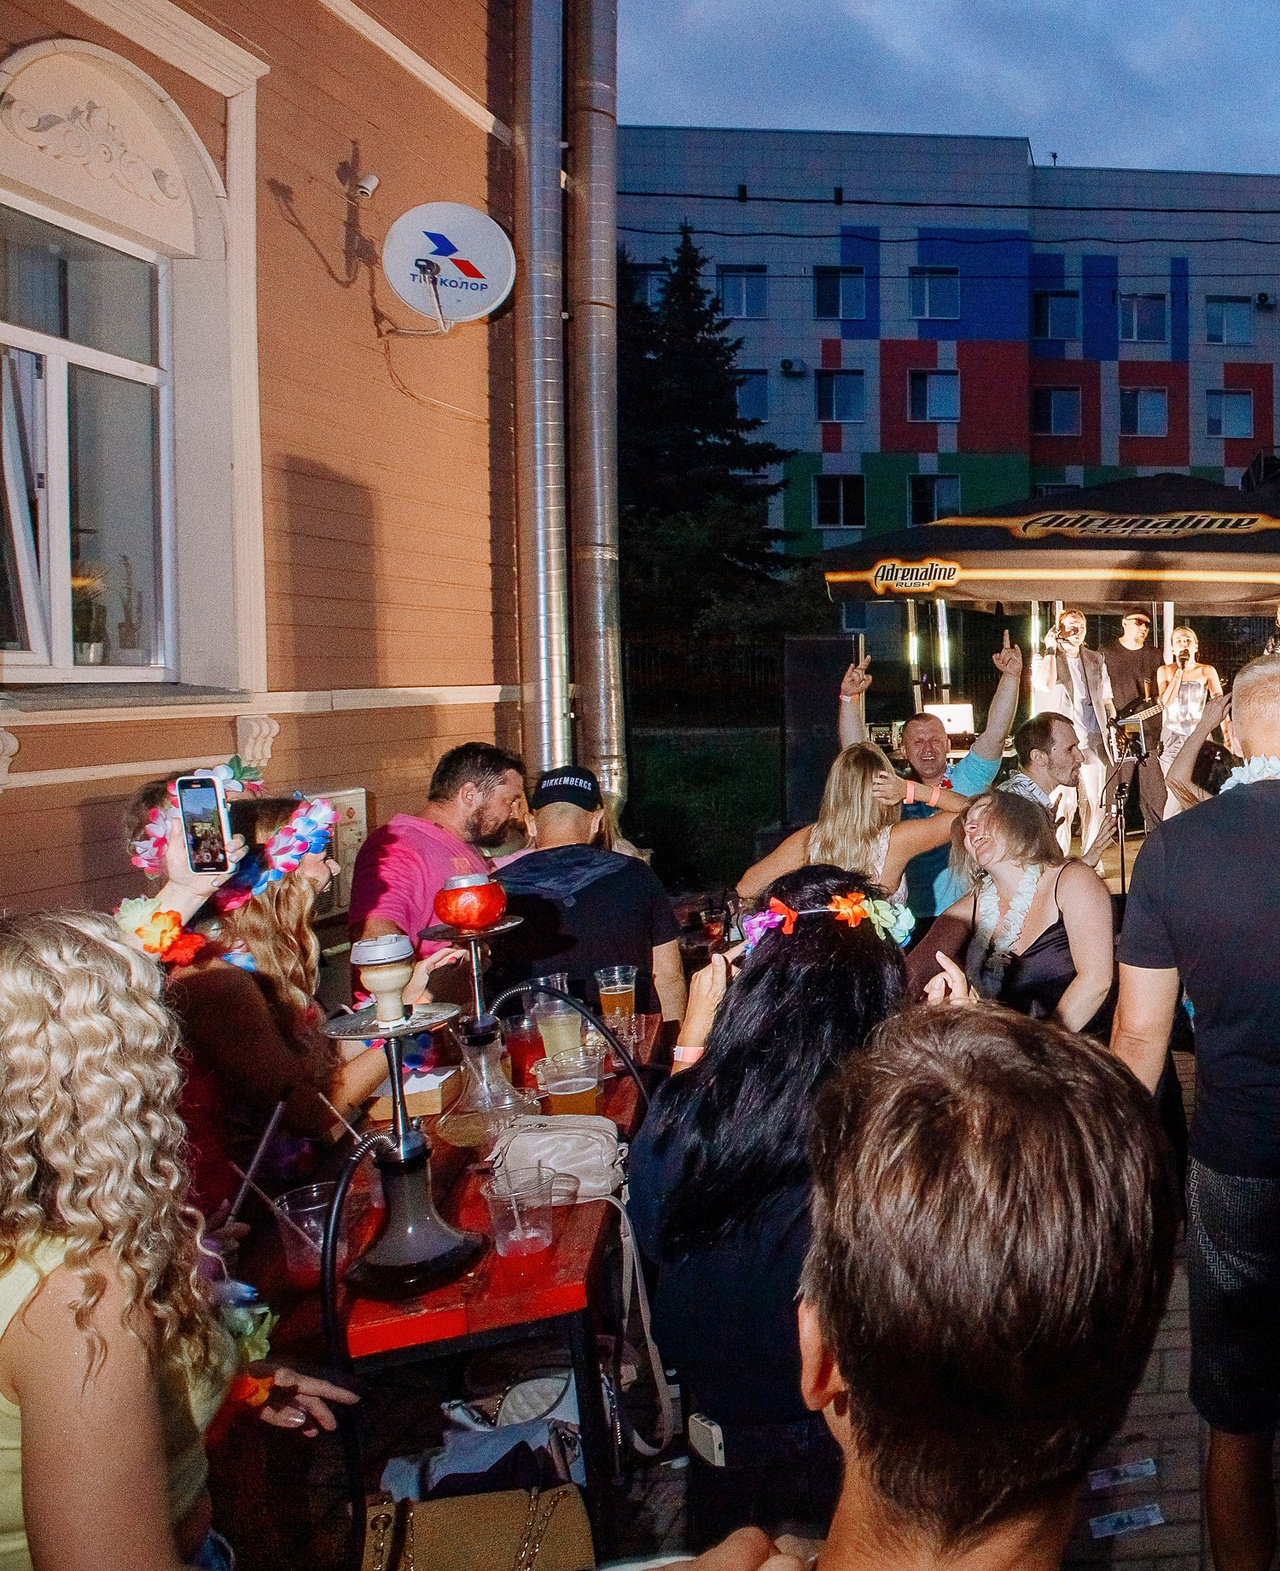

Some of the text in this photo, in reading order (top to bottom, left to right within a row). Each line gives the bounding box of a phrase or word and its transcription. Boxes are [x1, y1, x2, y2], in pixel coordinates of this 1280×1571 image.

[409, 272, 489, 292] ТКОЛОР
[1022, 514, 1259, 533] Adrenaline
[874, 562, 957, 588] Adrenaline
